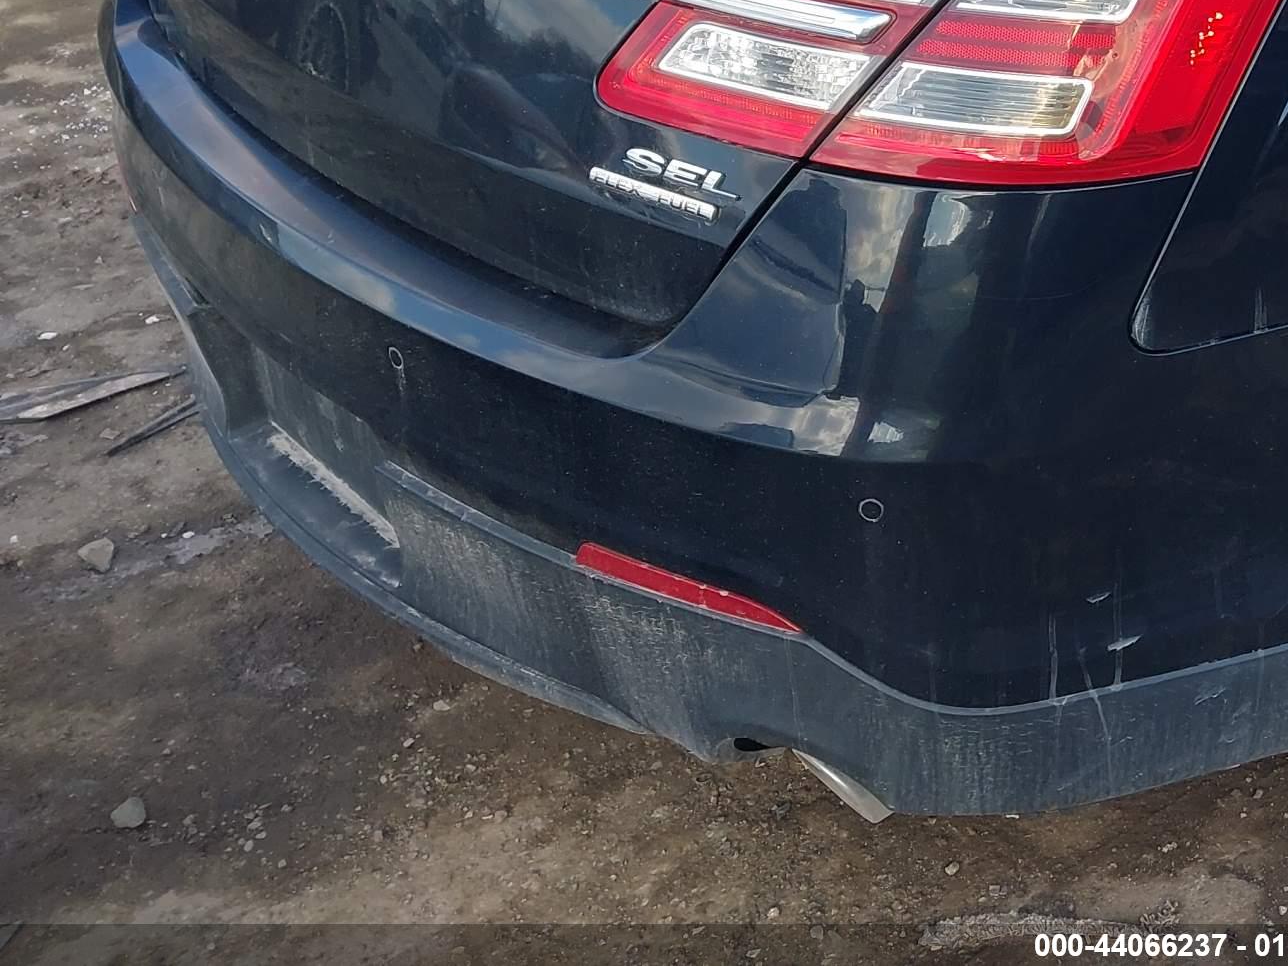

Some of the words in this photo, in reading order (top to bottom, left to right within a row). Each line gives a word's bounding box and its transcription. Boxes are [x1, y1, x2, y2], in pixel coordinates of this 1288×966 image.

[592, 170, 641, 197] FLEX
[656, 191, 711, 221] FUEL
[622, 147, 742, 200] SEL
